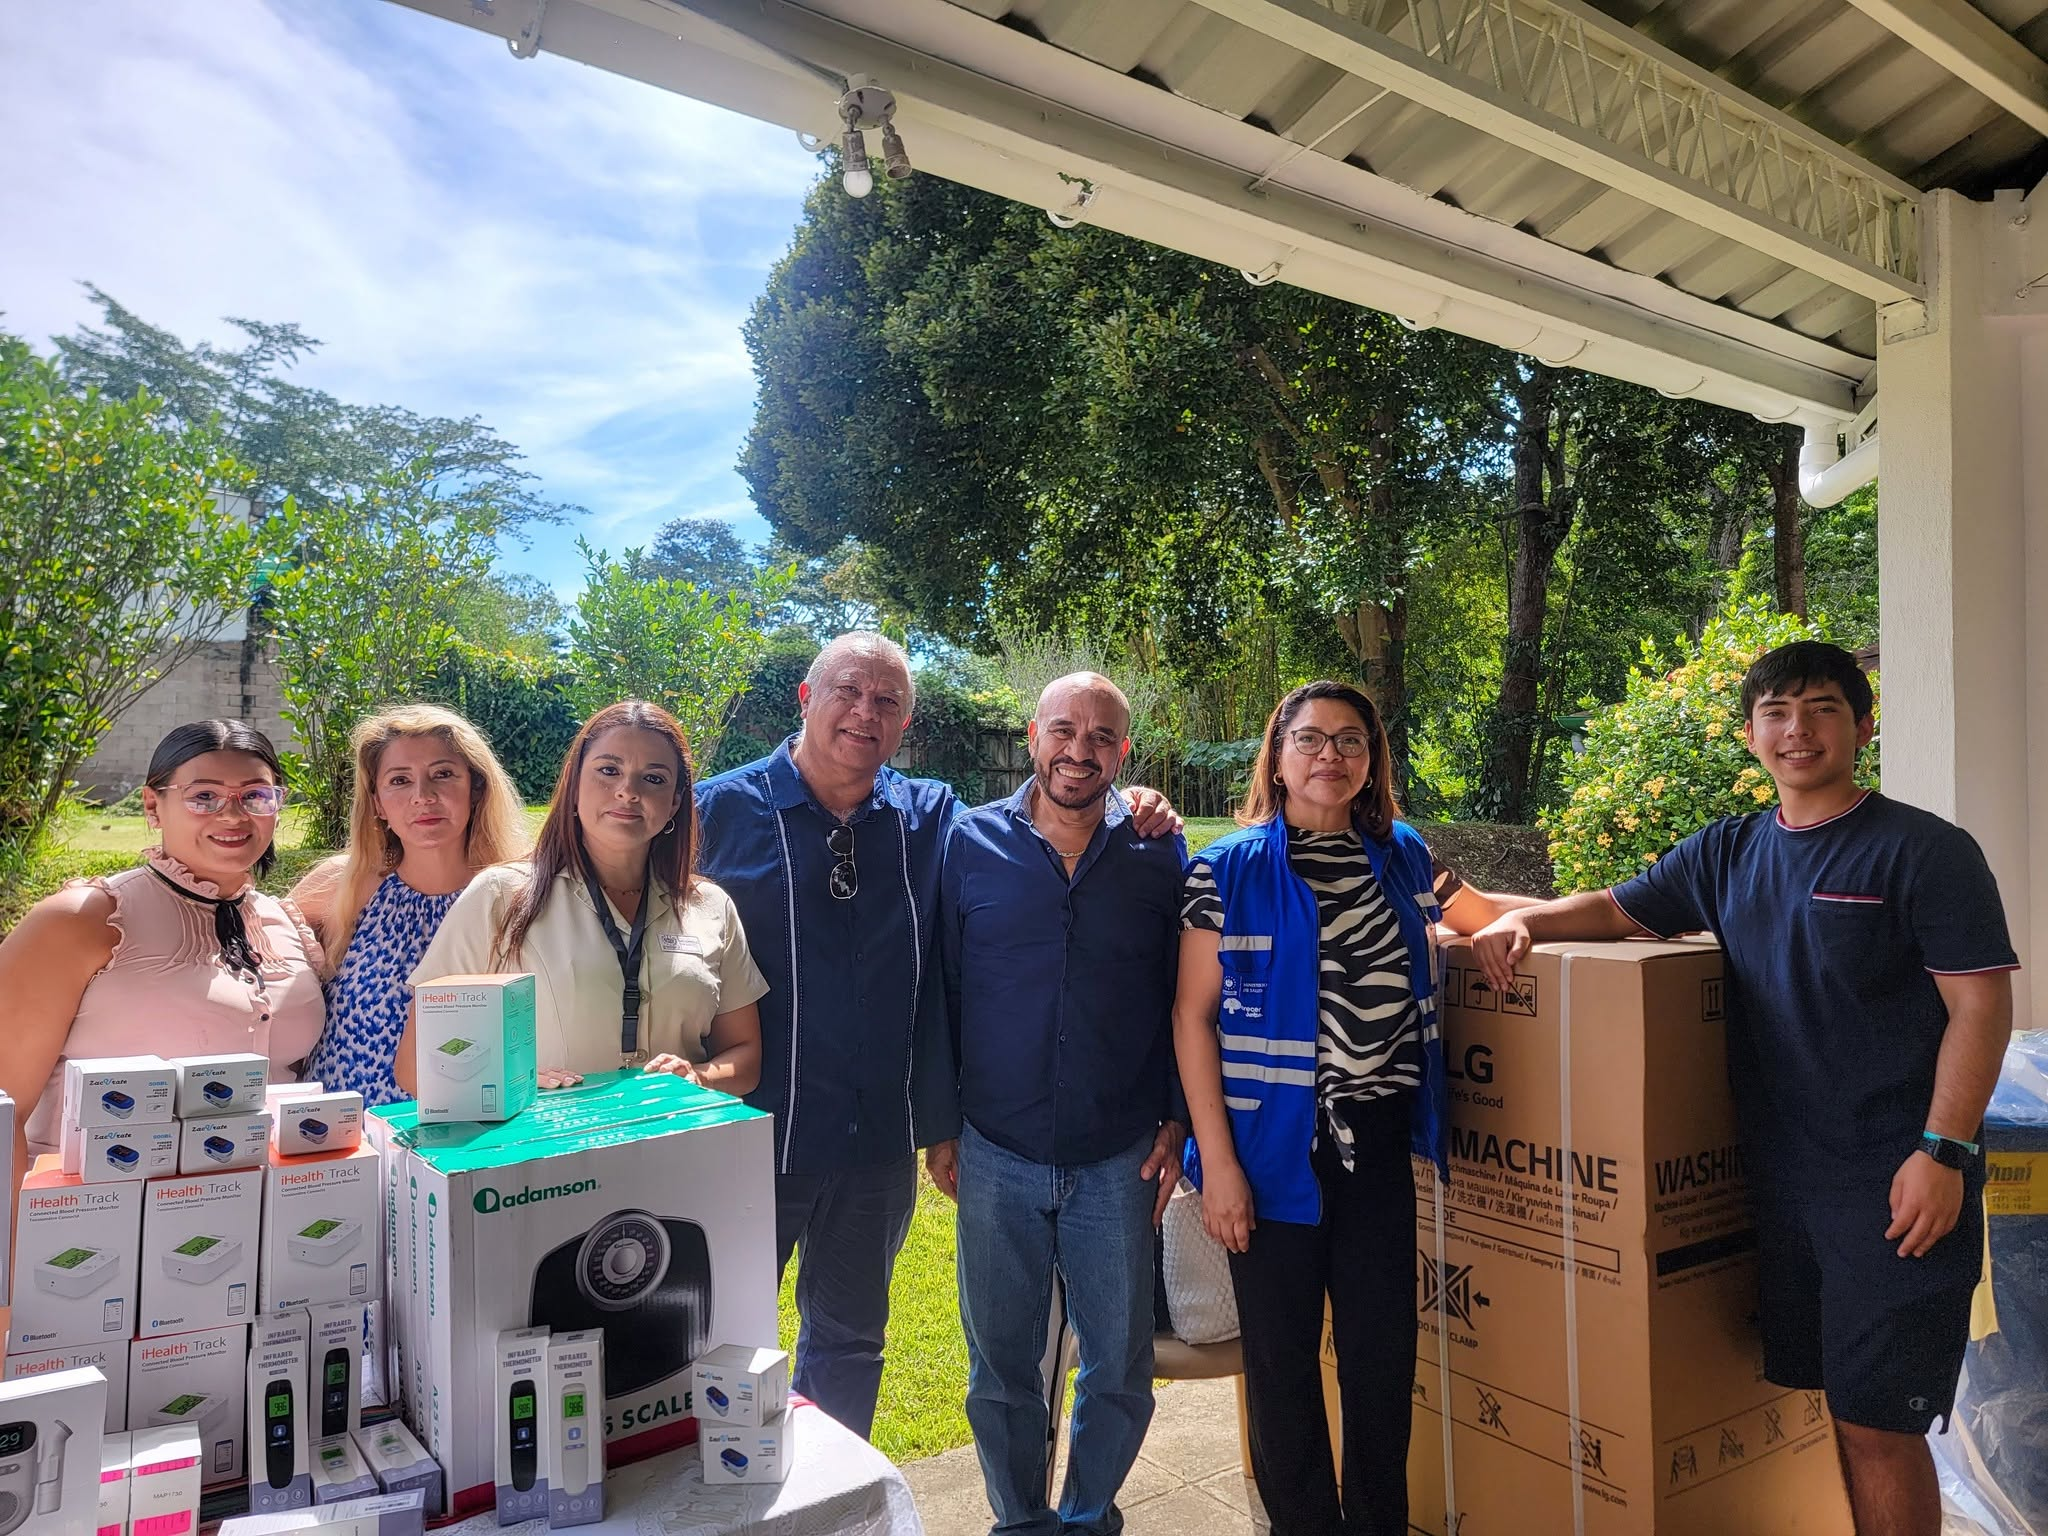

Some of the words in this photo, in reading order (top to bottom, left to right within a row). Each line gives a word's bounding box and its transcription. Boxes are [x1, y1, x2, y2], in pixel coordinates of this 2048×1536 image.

[422, 992, 457, 1003] iHealth
[461, 992, 487, 1002] Track
[1472, 1091, 1504, 1109] Good
[1451, 1127, 1618, 1194] MACHINE
[281, 1170, 324, 1186] iHealth
[329, 1165, 360, 1179] Track
[156, 1184, 202, 1200] iHealth
[208, 1180, 241, 1194] Track
[502, 1179, 597, 1208] adamson
[1504, 1175, 1540, 1191] Máquina
[1542, 1184, 1553, 1195] de
[1581, 1192, 1611, 1210] Roupa
[30, 1194, 78, 1210] iHealth
[84, 1191, 120, 1205] Track
[1432, 1206, 1456, 1223] SDE
[428, 1220, 436, 1317] adamson
[285, 1298, 309, 1307] Bluetooth
[159, 1317, 184, 1326] Bluetooth
[324, 1319, 352, 1329] INFRARED
[29, 1332, 57, 1342] Bluetooth
[267, 1328, 297, 1339] INFRARED
[319, 1325, 357, 1337] THERMOMETER
[1449, 1332, 1478, 1349] CLAMP
[142, 1342, 188, 1360] iHealth
[193, 1336, 227, 1351] Track
[507, 1348, 537, 1359] INFRARED
[263, 1350, 293, 1361] INFRARED
[503, 1356, 542, 1368] THERMOMETER
[559, 1352, 588, 1362] INFRARED
[15, 1357, 65, 1376] iHealth
[70, 1352, 106, 1367] Track
[258, 1357, 299, 1369] THERMOMETER
[554, 1360, 593, 1371] THERMOMETER
[622, 1391, 693, 1429] SCALE
